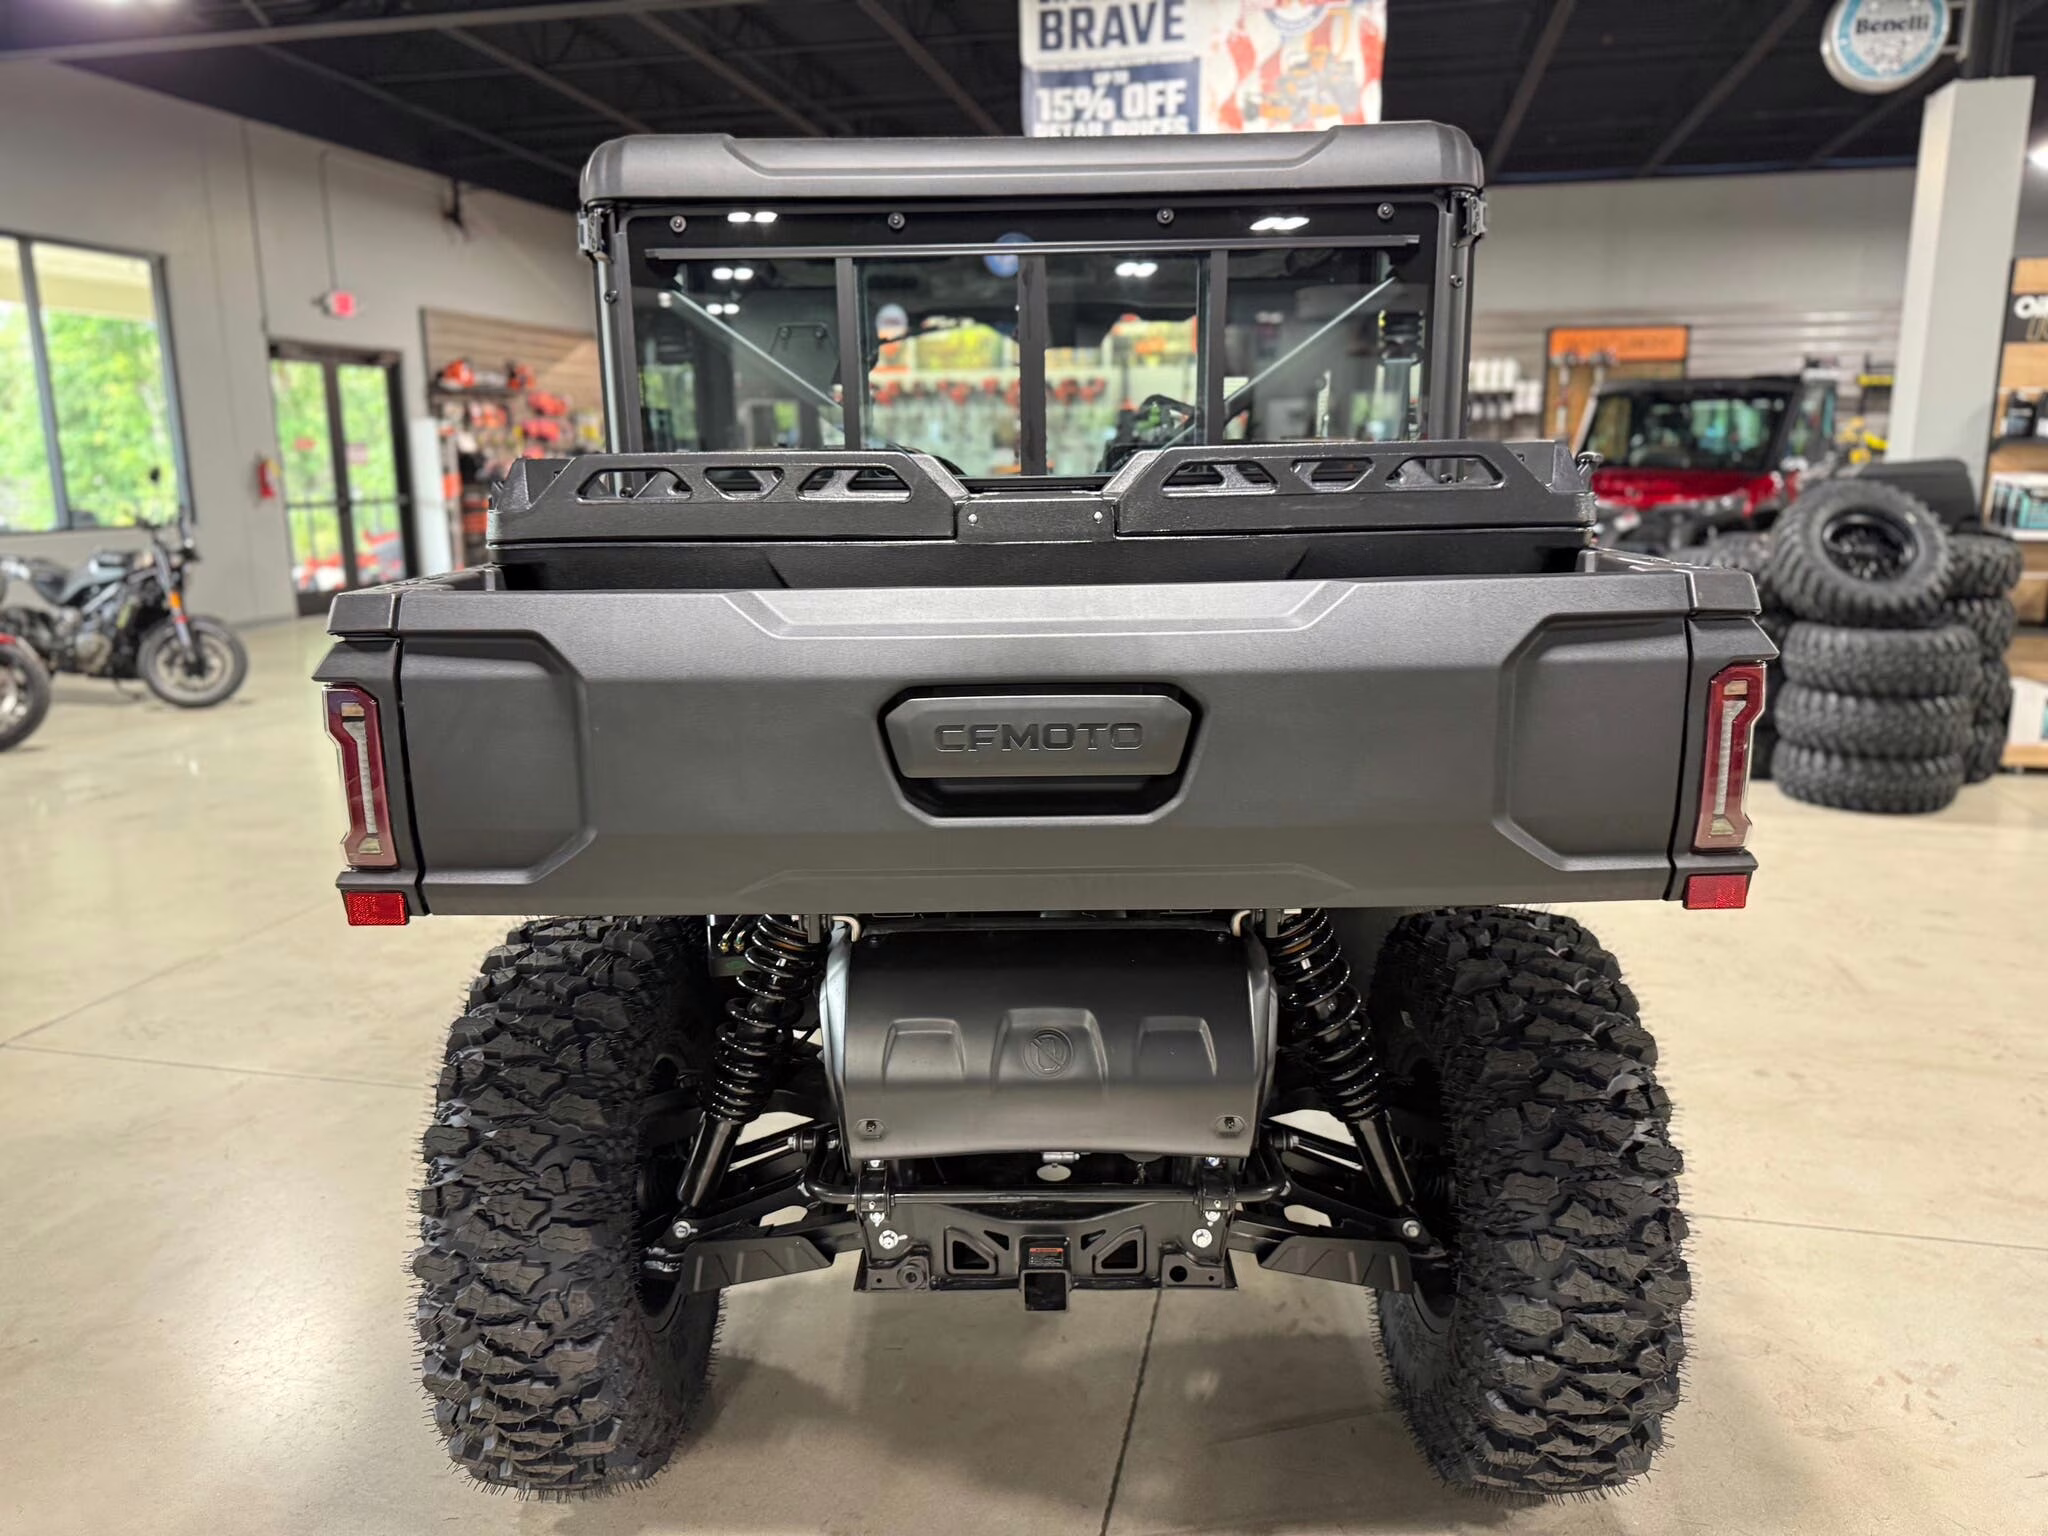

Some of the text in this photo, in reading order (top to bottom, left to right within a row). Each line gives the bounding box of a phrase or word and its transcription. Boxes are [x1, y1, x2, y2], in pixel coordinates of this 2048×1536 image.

[1039, 0, 1185, 51] BRAVE
[1856, 15, 1929, 34] Benelli
[1035, 79, 1188, 122] 15% OFF
[934, 722, 1143, 752] CFMOTO
